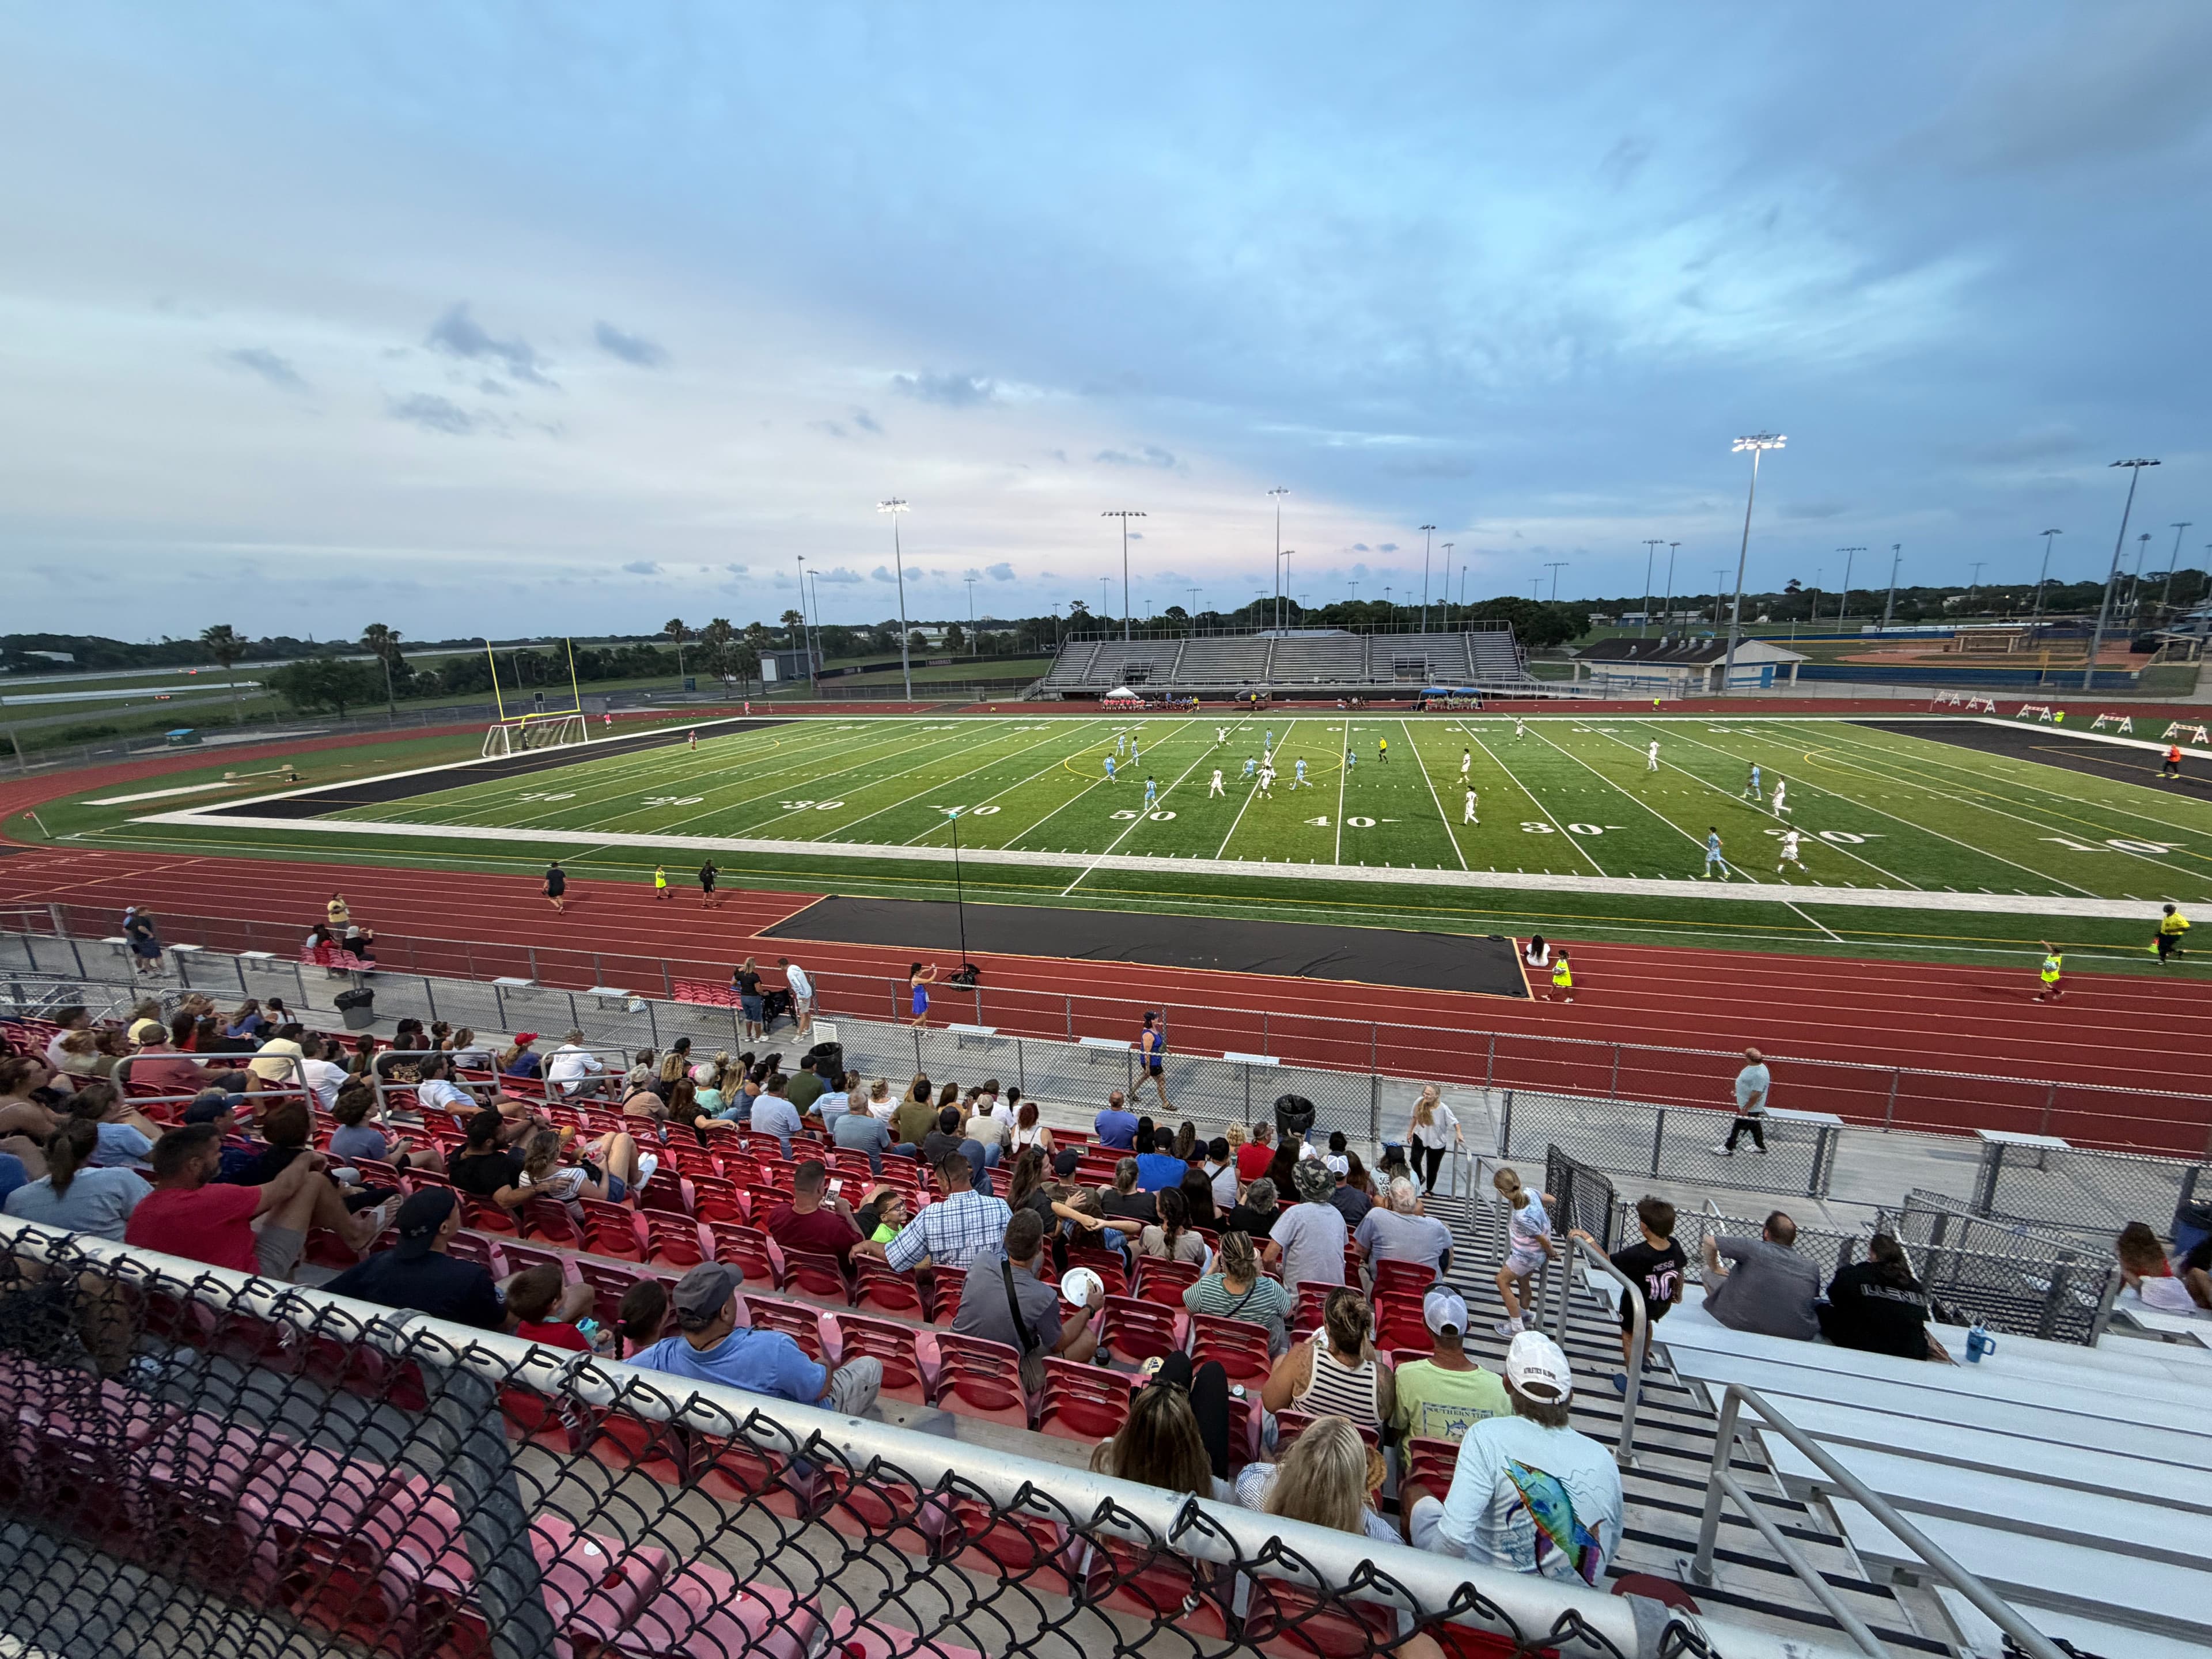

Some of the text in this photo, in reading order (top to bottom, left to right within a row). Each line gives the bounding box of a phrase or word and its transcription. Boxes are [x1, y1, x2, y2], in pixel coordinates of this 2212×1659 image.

[515, 793, 577, 801] 10
[640, 796, 704, 805] 20
[782, 800, 846, 810] 30
[938, 805, 1002, 816] 40
[1109, 810, 1177, 821] 50
[1303, 816, 1376, 828] 40
[1520, 822, 1604, 835] 30
[1763, 829, 1865, 844] 20
[2036, 838, 2169, 853] 10
[1645, 1270, 1679, 1301] 10
